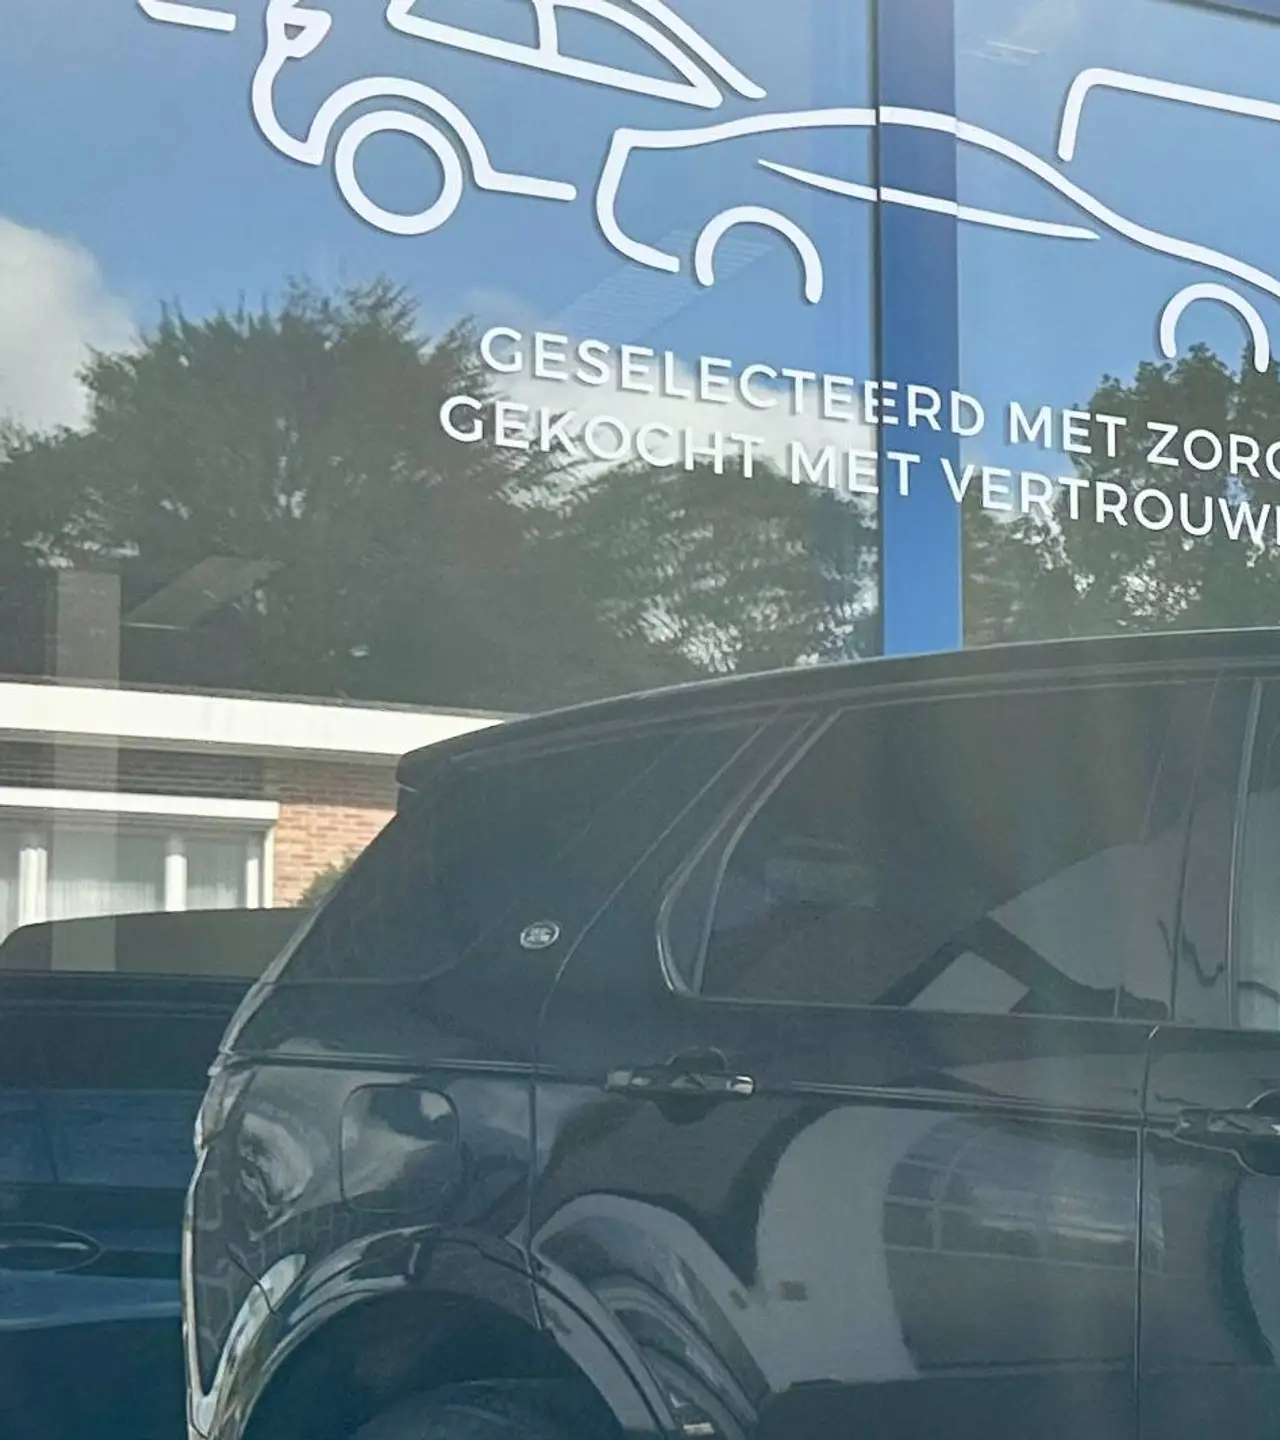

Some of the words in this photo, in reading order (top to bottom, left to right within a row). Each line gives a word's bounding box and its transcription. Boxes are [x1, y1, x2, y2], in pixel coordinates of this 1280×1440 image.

[439, 394, 765, 479] GEKOCHT
[790, 439, 921, 498] MET
[479, 326, 985, 437] GESELECTEERD
[1009, 400, 1127, 458] MET
